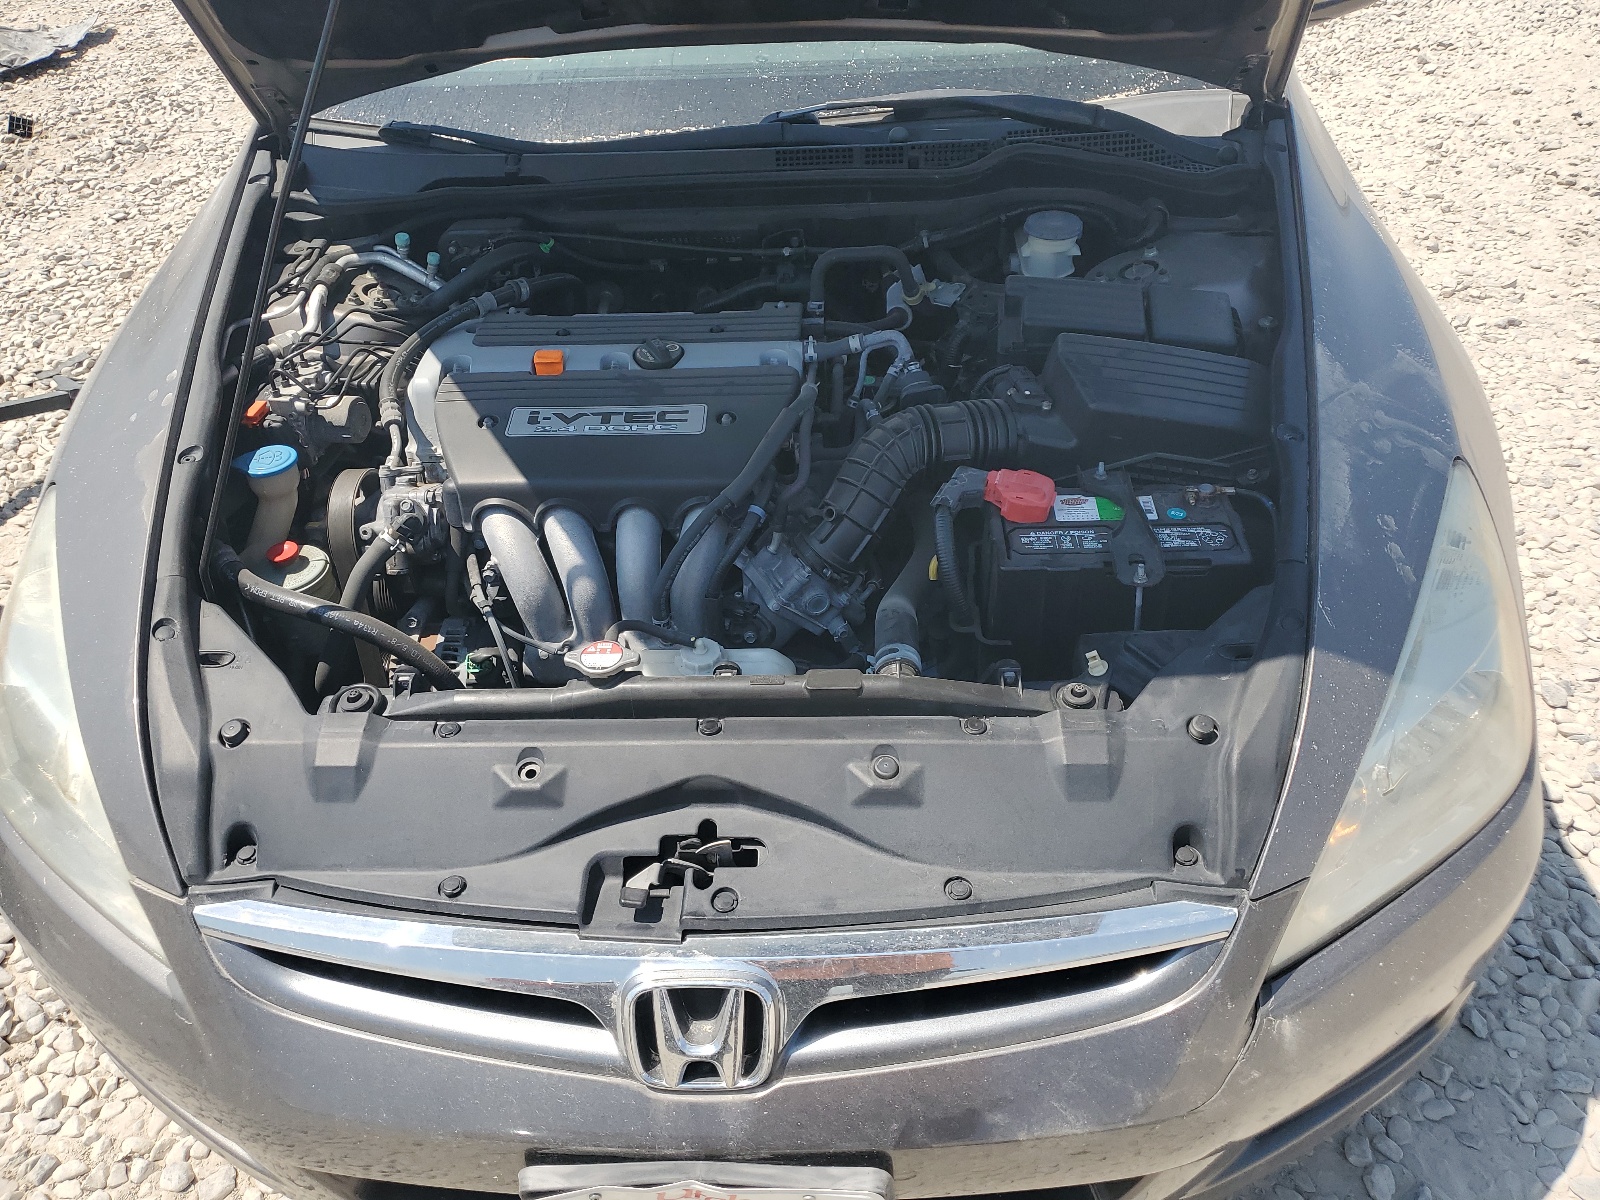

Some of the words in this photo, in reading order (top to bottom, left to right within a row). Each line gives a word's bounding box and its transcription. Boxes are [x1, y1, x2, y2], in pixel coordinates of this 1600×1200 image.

[527, 410, 690, 425] i-VTEC
[534, 425, 577, 433] 2.4
[583, 424, 678, 432] DOHC
